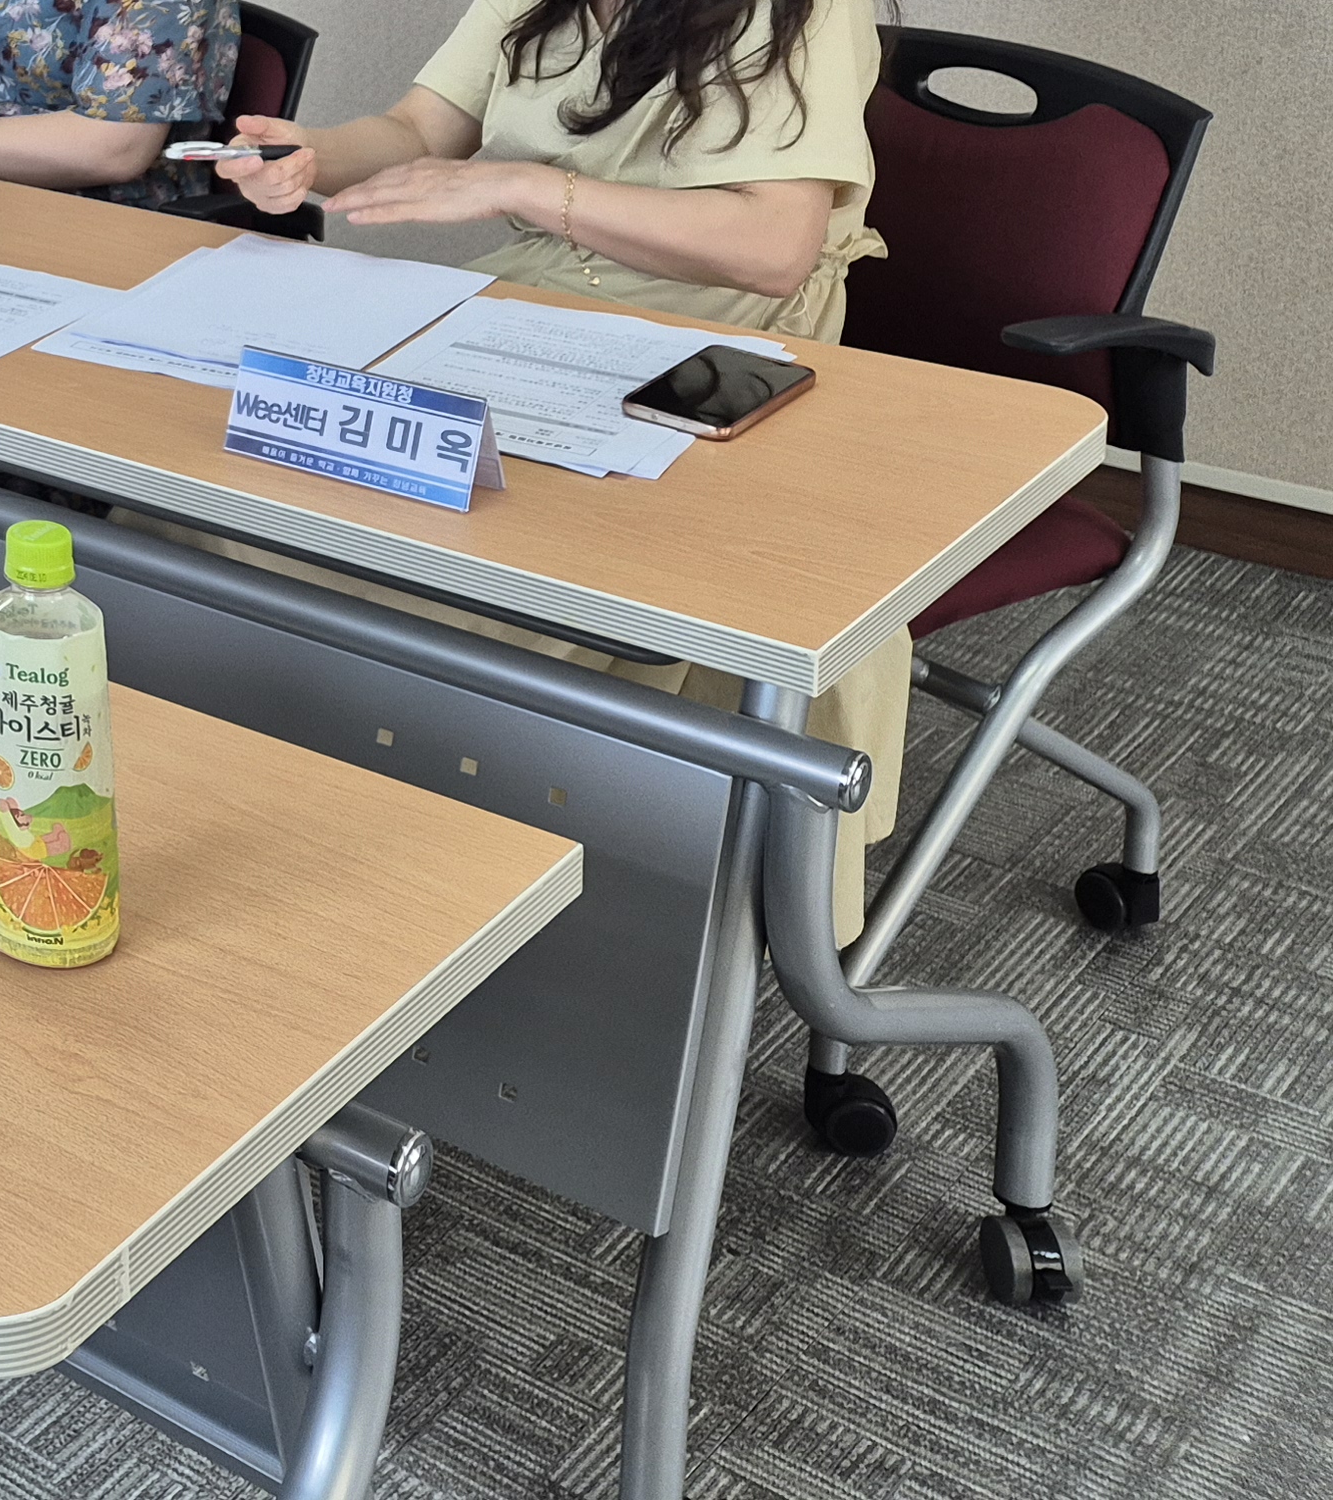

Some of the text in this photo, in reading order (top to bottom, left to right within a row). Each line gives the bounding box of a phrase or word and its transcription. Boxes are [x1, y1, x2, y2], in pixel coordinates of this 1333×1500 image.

[306, 364, 414, 405] 창녕교육지원청
[5, 662, 70, 688] Tealog
[1, 690, 76, 716] 제주청귤
[19, 748, 62, 769] ZERO
[27, 770, 54, 781] 0 kcal
